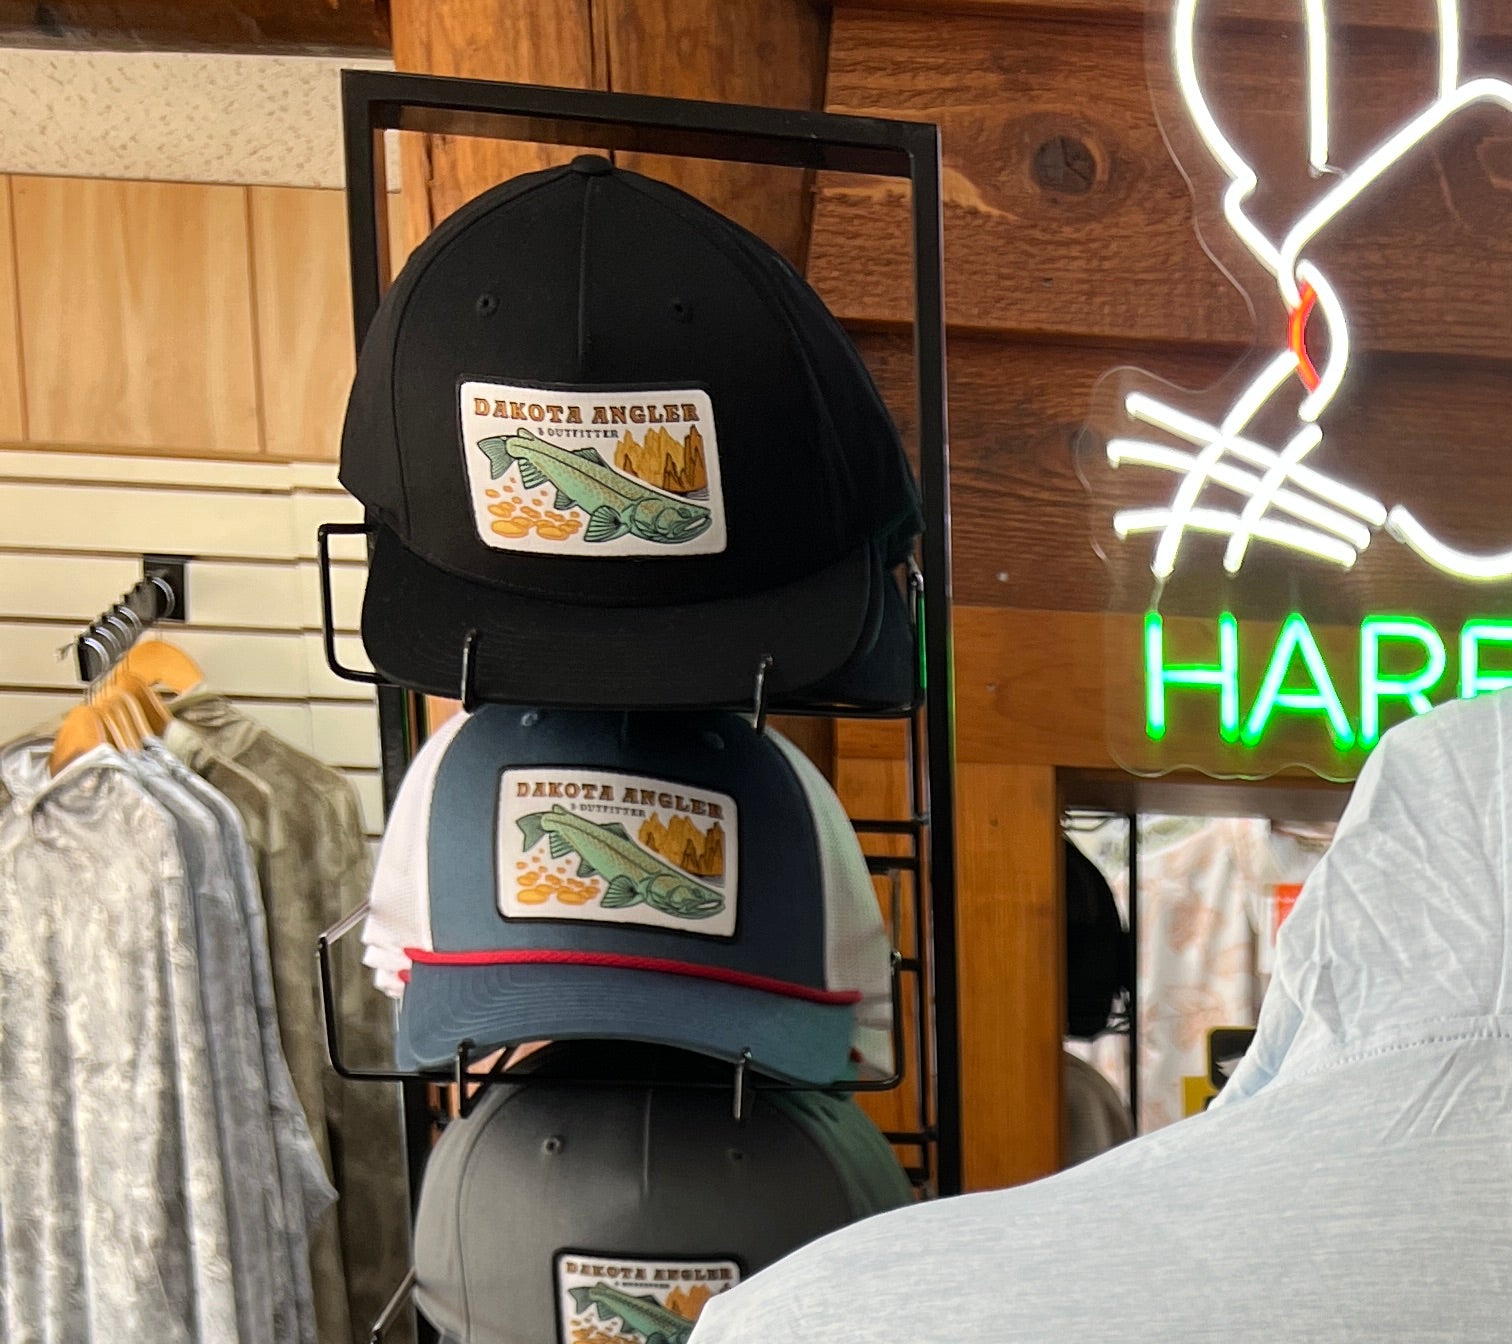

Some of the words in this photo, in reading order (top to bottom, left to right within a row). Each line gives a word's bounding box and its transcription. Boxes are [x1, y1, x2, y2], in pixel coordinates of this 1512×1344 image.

[473, 397, 583, 424] DAKOTA
[592, 403, 701, 424] ANGLER
[547, 427, 619, 439] OUTFITTER
[516, 781, 614, 802] DAKOTA
[623, 787, 724, 820] ANGLER
[579, 803, 647, 818] OUTFITTER
[565, 1261, 647, 1281] DAKOTA
[653, 1267, 733, 1281] ANGLER
